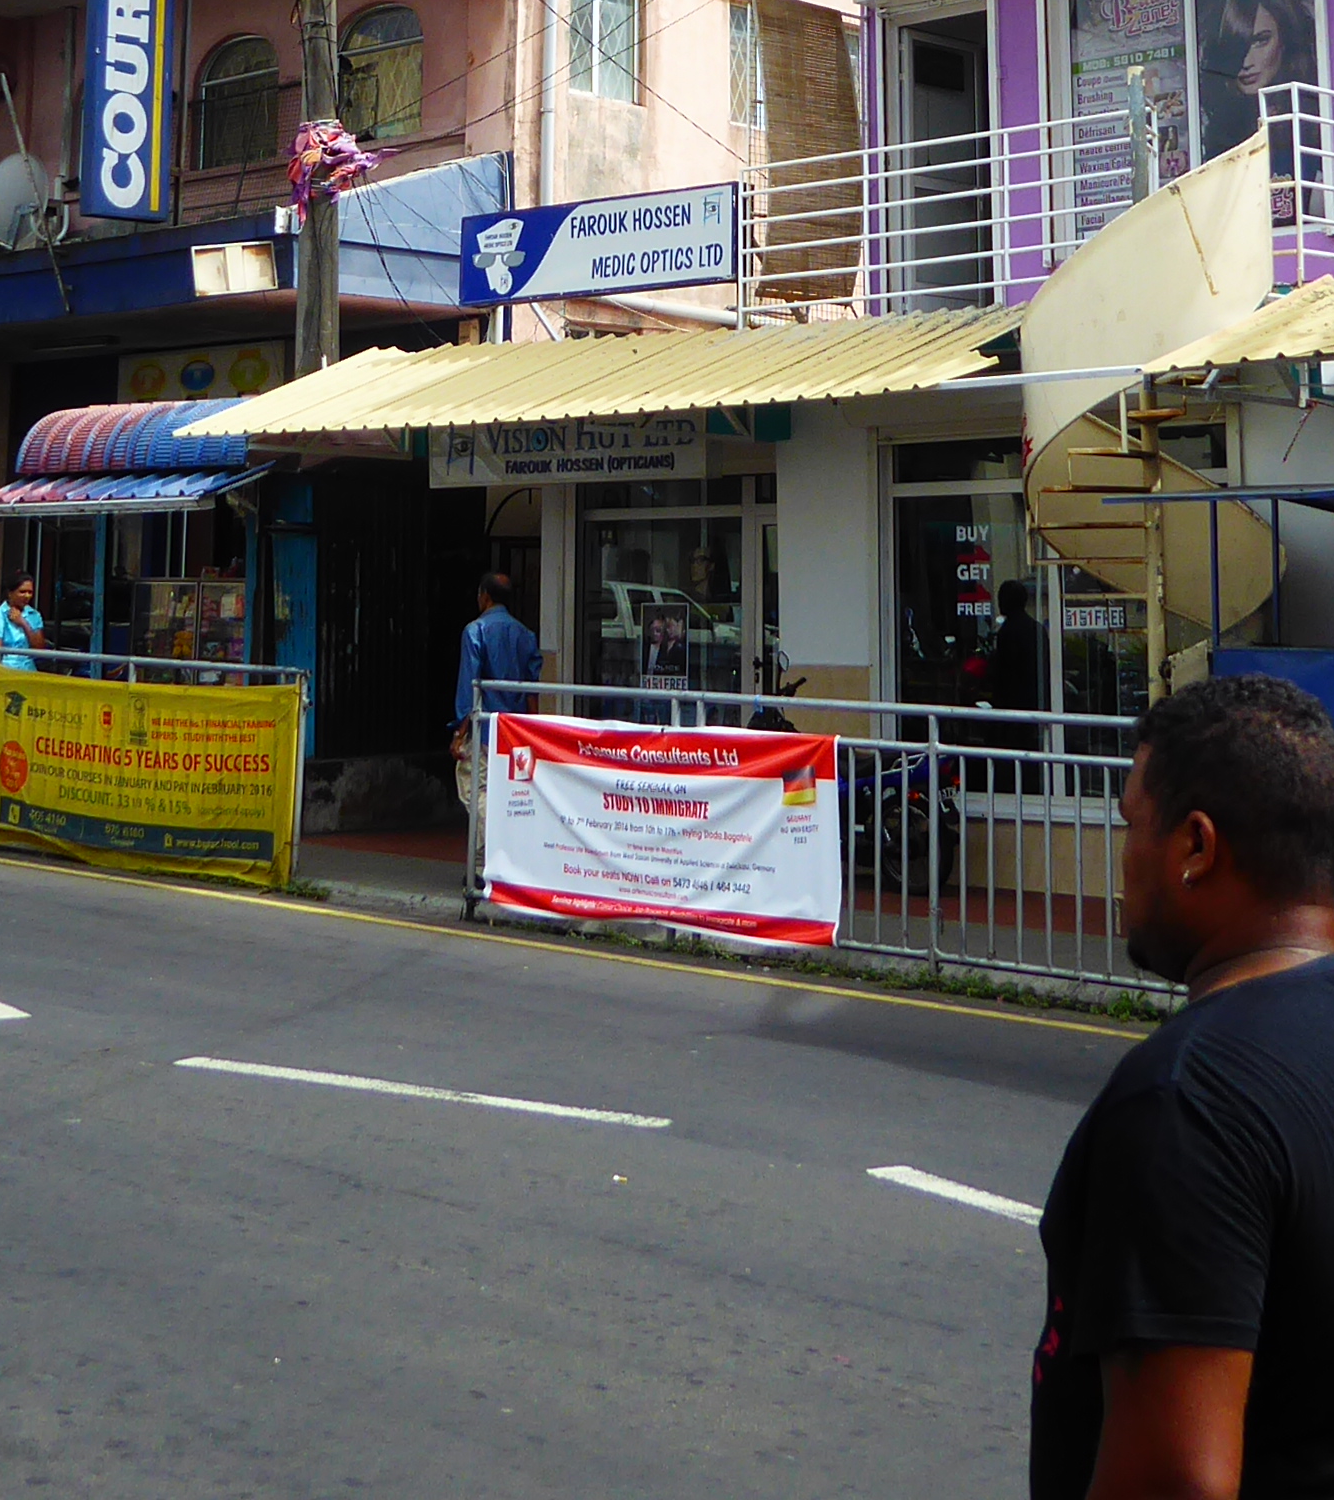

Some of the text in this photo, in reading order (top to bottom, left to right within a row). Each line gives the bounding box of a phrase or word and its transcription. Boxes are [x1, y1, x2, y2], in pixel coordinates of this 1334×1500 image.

[1077, 91, 1113, 104] Brushing
[1078, 125, 1116, 139] Défrisant
[570, 202, 691, 238] FAROUK HOSSEN
[591, 243, 723, 279] MEDIC OPTICS LTD
[505, 452, 675, 475] FAROUK HOSSEN (OPTICIANS)
[956, 526, 989, 542] BUY
[956, 564, 990, 580] GET
[957, 603, 991, 615] FREE
[28, 705, 84, 723] BSP SCHOOL
[35, 736, 121, 767] CELEBRATING
[124, 749, 133, 767] 5
[137, 750, 179, 771] YEARS
[182, 753, 202, 772] OF
[205, 754, 270, 772] SUCCESS
[578, 740, 739, 766] Artemus Consultants Ltd
[47, 765, 64, 778] OUR
[67, 768, 102, 783] COURSES
[104, 774, 112, 786] IN
[114, 775, 152, 789] JANUARY
[153, 779, 171, 791] AND
[173, 780, 188, 792] PAY
[191, 783, 200, 794] IN
[201, 782, 246, 795] FEBRUARY
[249, 783, 273, 797] 2016
[616, 779, 635, 792] FREE
[674, 784, 687, 795] ON
[603, 792, 709, 820] STUDY TO IMMIGRATE
[586, 818, 613, 831] February
[630, 822, 644, 832] from
[563, 863, 581, 875] Book
[584, 868, 599, 878] your
[644, 874, 659, 886] Call
[661, 878, 671, 887] on
